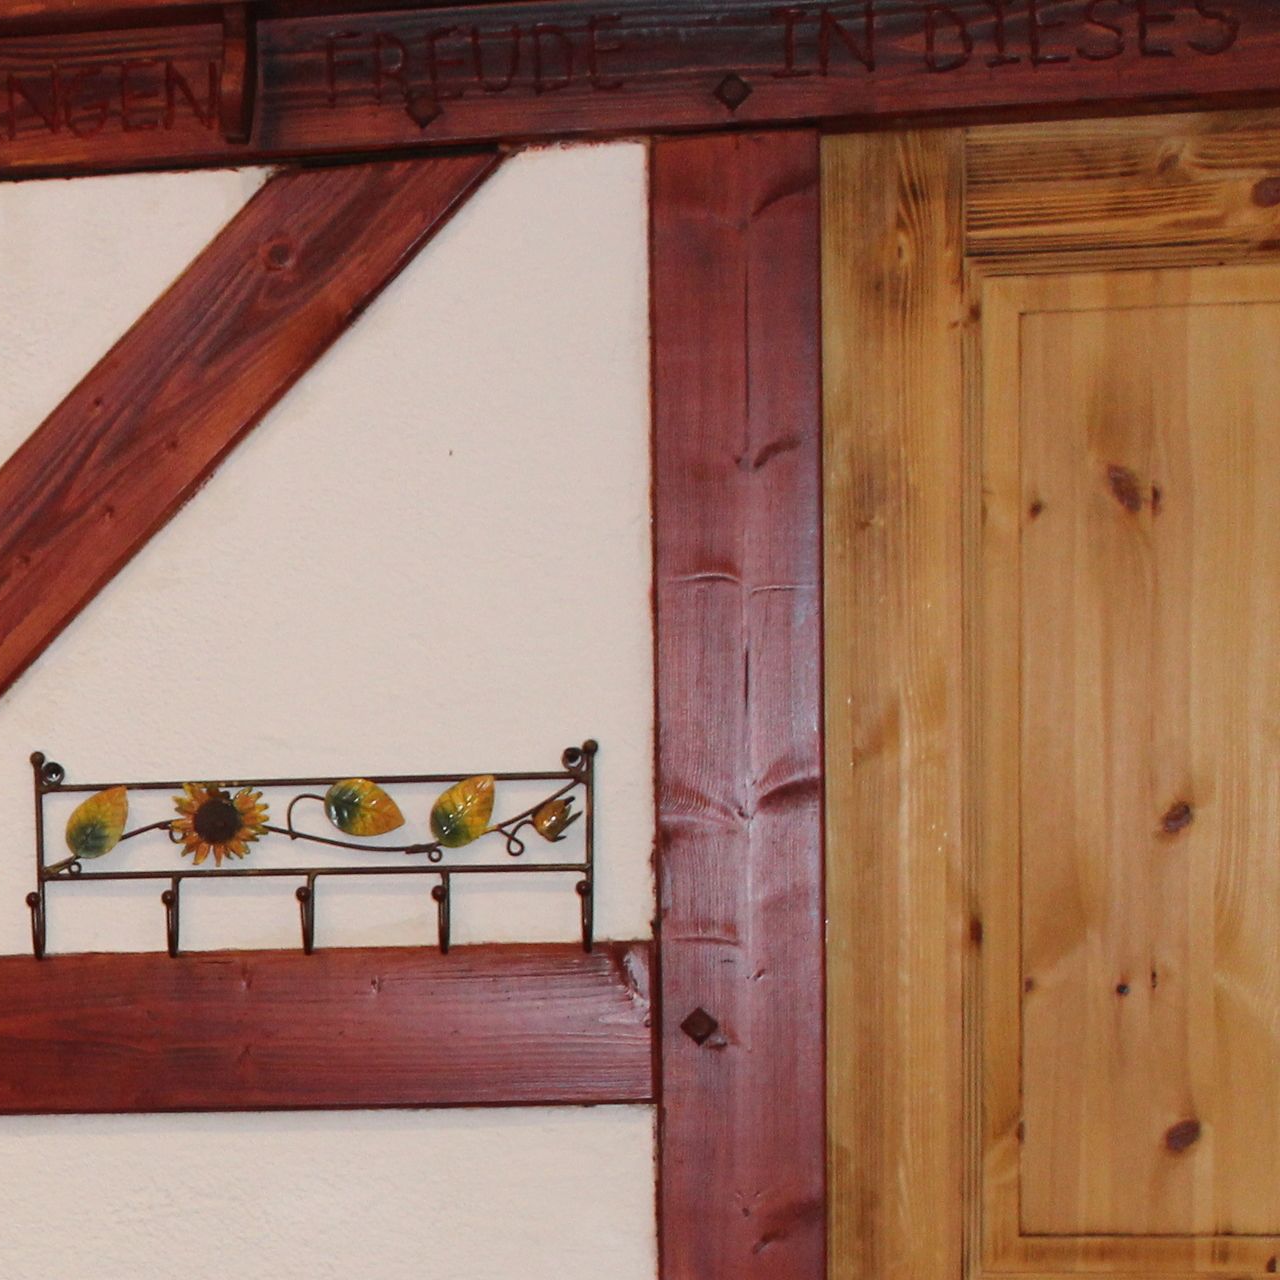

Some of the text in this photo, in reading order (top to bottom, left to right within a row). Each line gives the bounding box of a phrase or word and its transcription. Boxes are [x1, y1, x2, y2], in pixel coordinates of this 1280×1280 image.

[325, 13, 624, 104] FREUDE
[769, 0, 876, 80] IN
[924, 0, 1239, 74] DIESES
